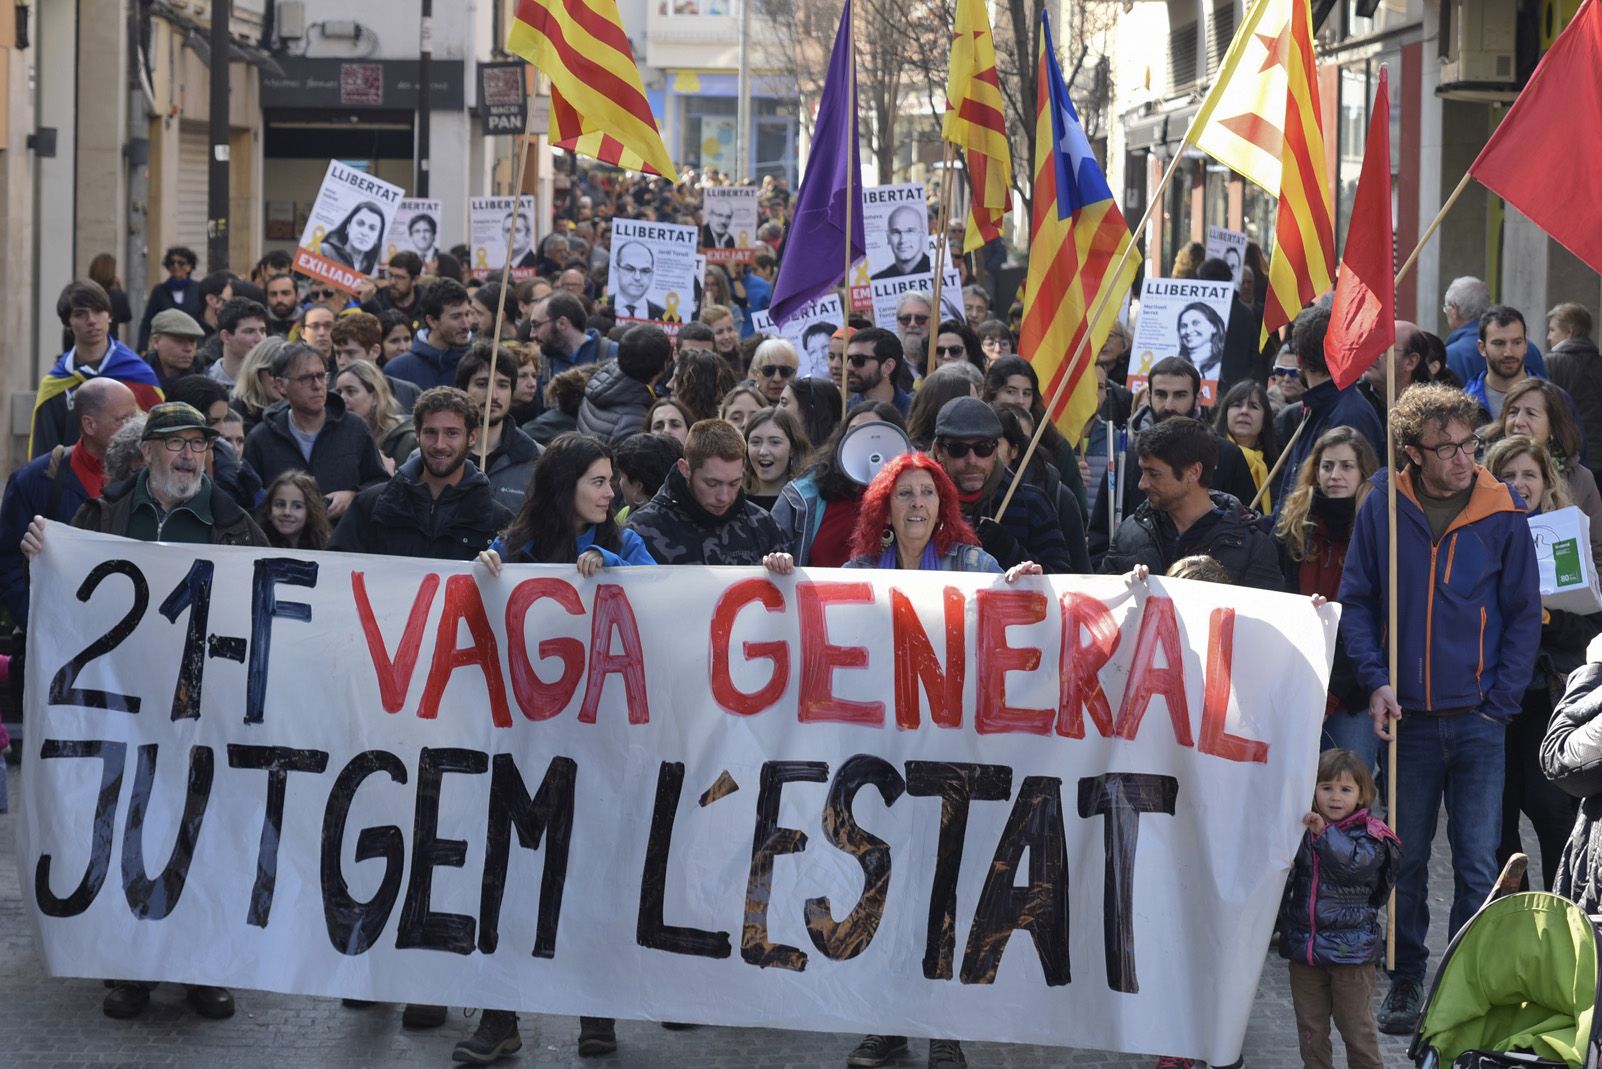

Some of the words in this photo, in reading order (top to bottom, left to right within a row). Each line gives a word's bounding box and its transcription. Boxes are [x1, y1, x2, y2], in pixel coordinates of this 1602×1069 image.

[489, 115, 522, 130] PAN
[331, 166, 400, 203] LLIBERTAT
[706, 189, 756, 198] LLIBERTAT
[863, 187, 924, 203] IBERTAT
[401, 202, 439, 211] BERTAT
[472, 199, 533, 210] LLIBERAT
[615, 223, 695, 243] LLIBERTAT
[1209, 228, 1247, 246] LLIBERTAT
[1146, 283, 1229, 299] LLIBERTAT
[48, 558, 319, 726] 21-F
[351, 570, 650, 728] VAGA
[708, 578, 1270, 764] GENERAL
[34, 739, 578, 959] JUTGEM
[636, 753, 1180, 994] L'ESTAT
